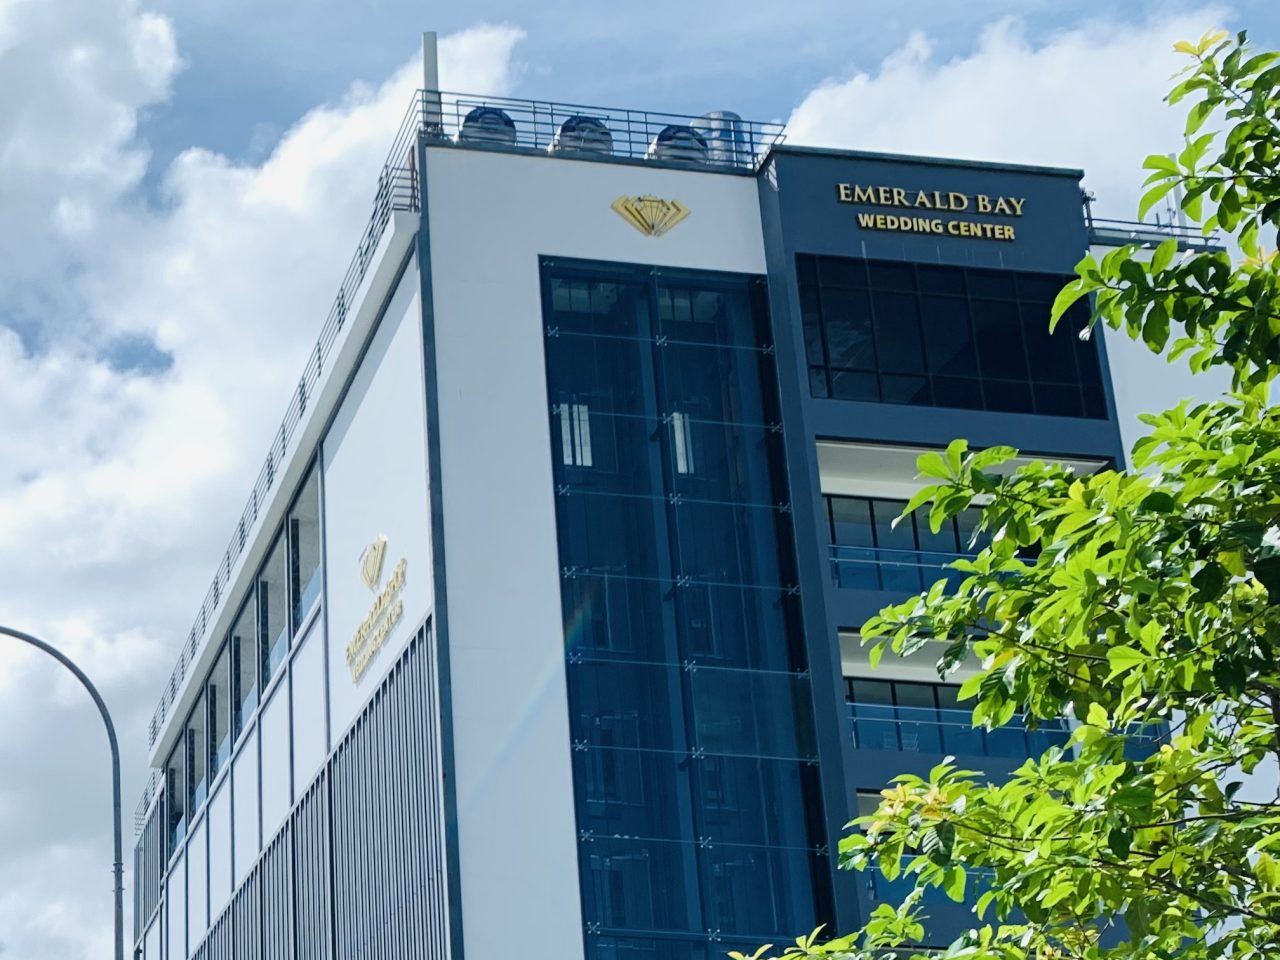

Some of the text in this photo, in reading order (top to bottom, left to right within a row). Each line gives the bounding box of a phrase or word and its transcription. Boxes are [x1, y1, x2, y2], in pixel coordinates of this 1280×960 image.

[837, 183, 1026, 215] EMERALD BAY
[857, 213, 1016, 240] WEDDING CENTER
